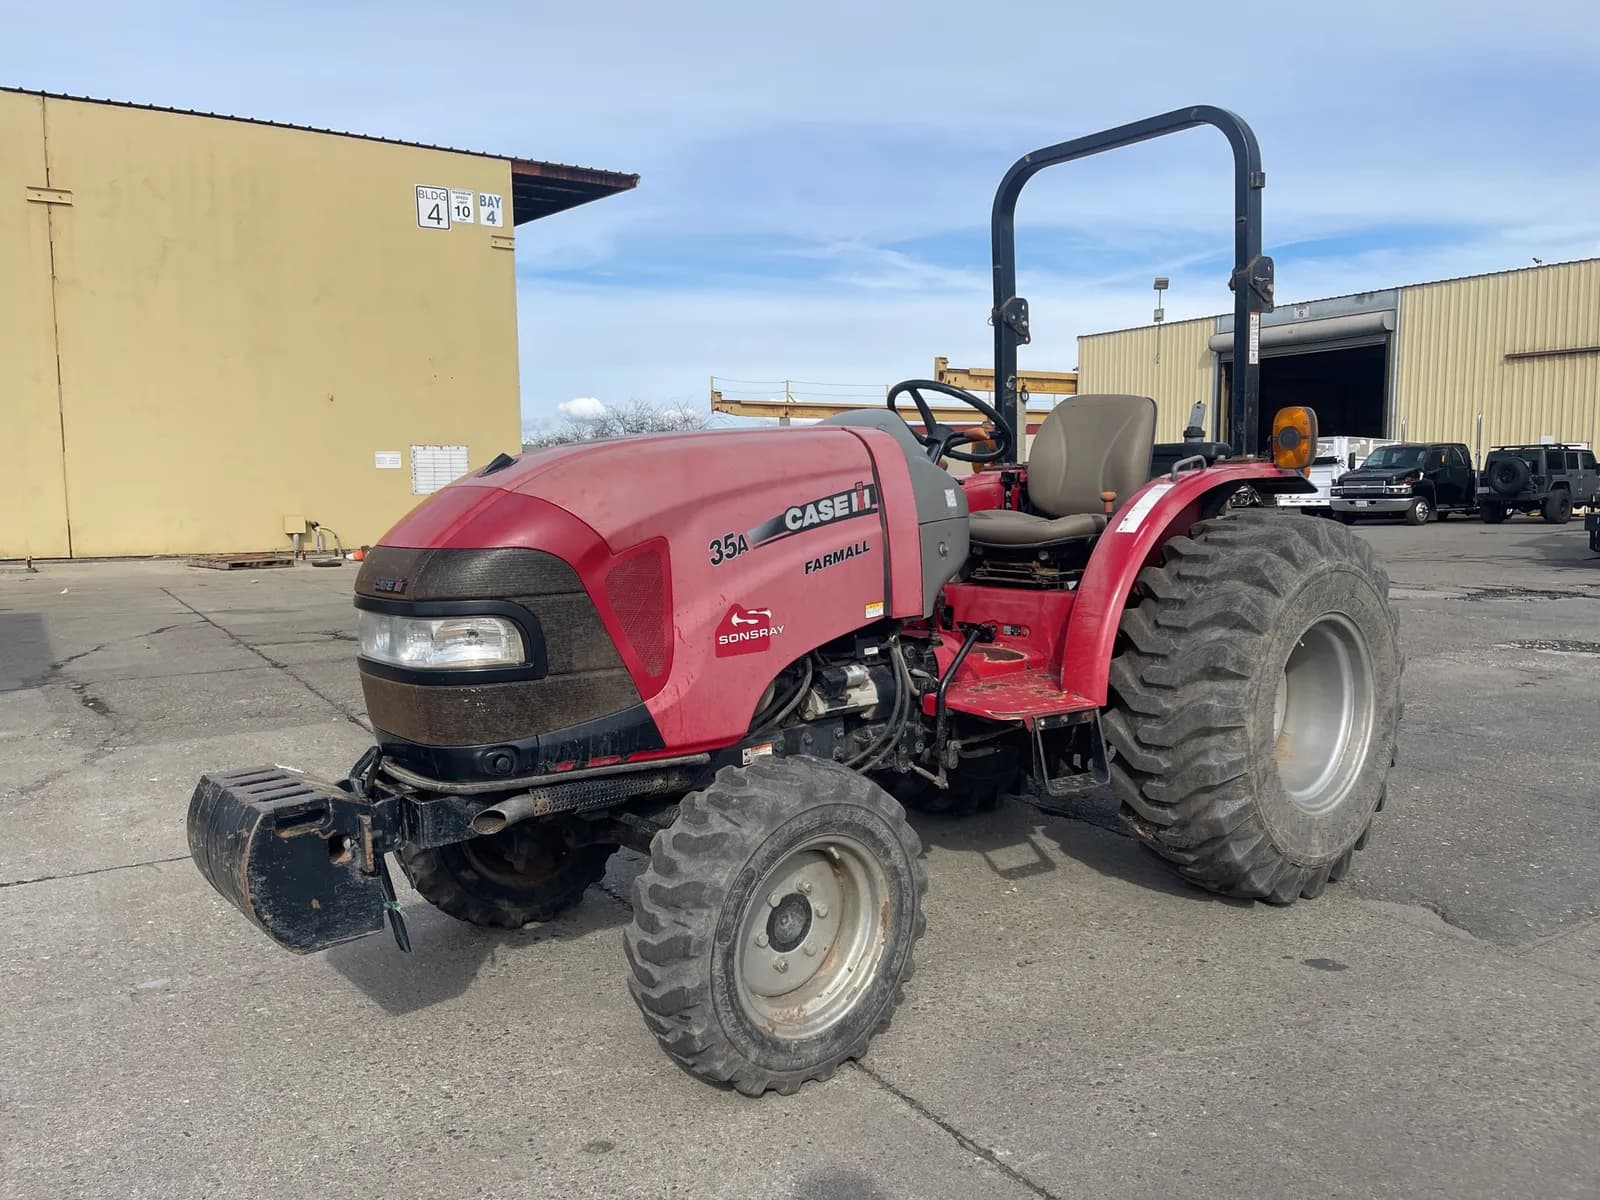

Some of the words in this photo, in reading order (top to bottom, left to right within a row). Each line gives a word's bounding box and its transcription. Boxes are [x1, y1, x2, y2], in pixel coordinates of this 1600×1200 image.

[418, 189, 446, 201] BLDG
[480, 194, 501, 208] BAY
[427, 203, 443, 225] 4
[454, 205, 471, 218] 10
[486, 210, 497, 225] 4
[785, 494, 850, 531] CASE
[709, 532, 750, 566] 35A
[804, 540, 871, 575] FARMALL
[718, 624, 785, 645] SONSRAY
